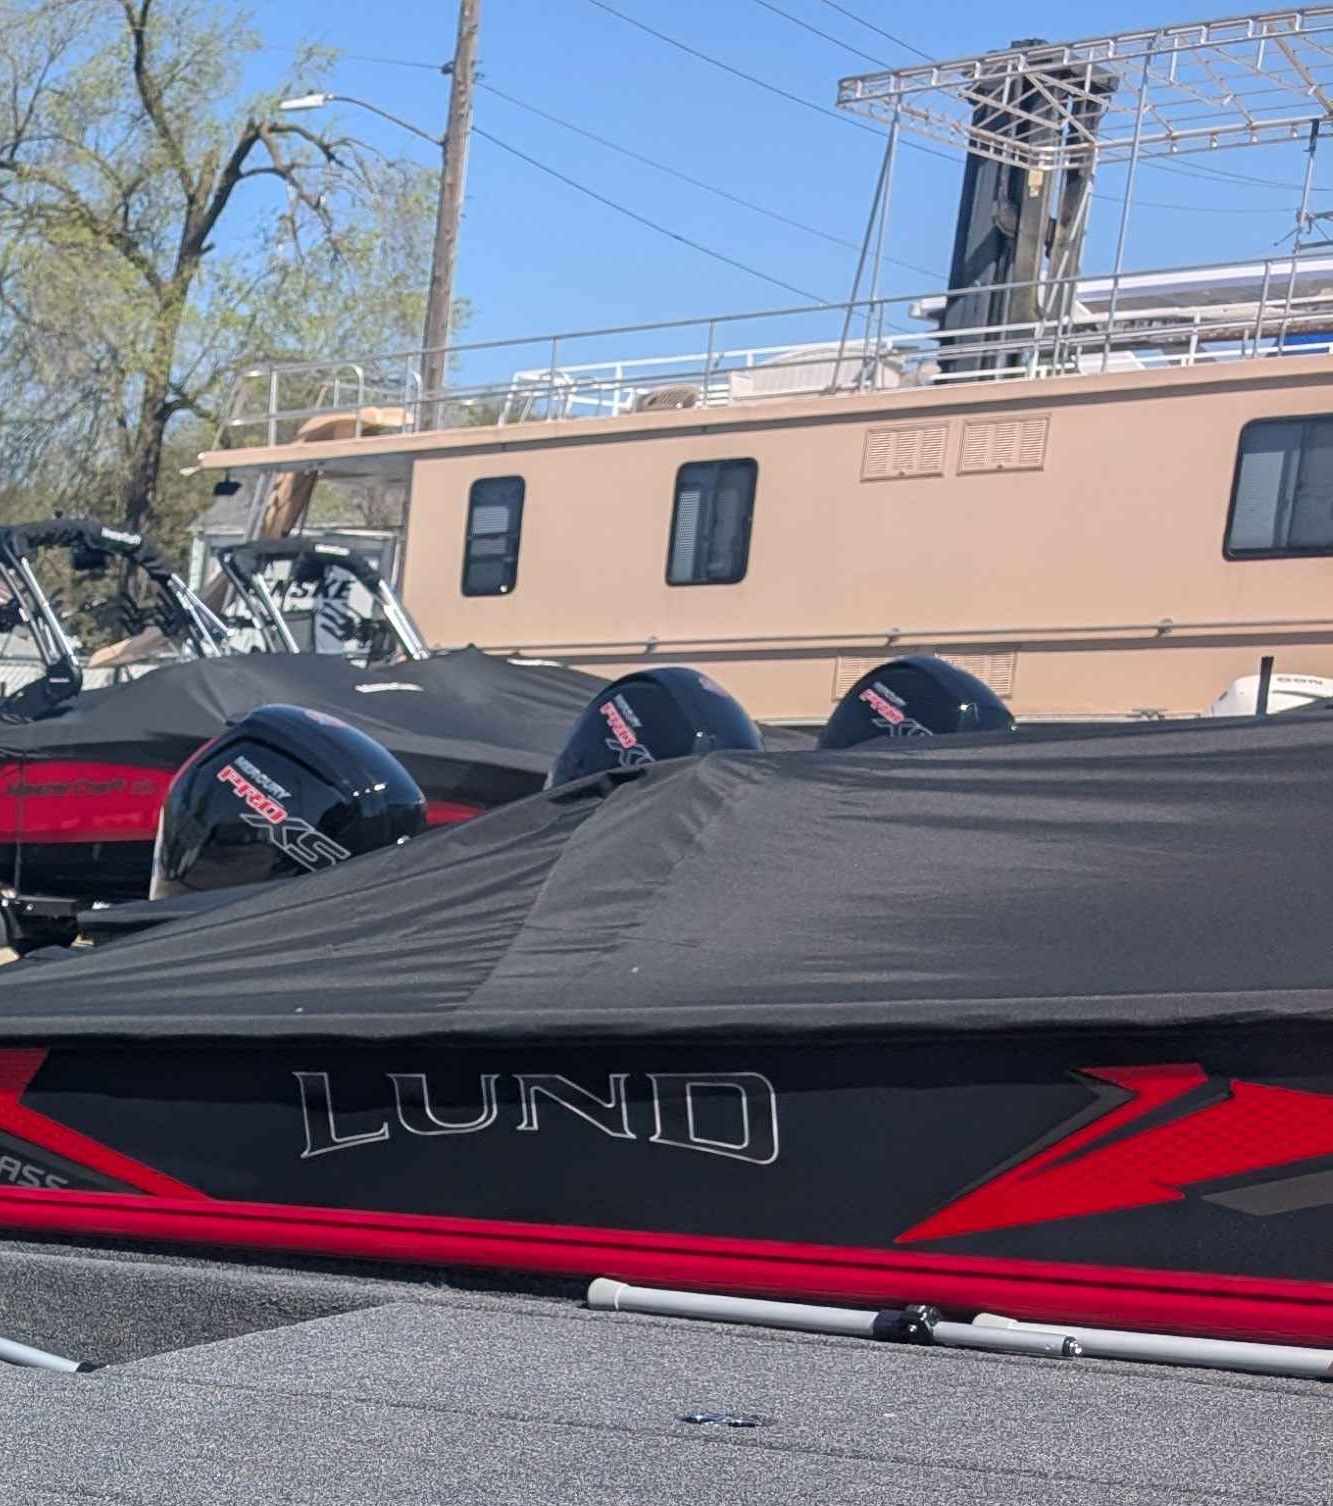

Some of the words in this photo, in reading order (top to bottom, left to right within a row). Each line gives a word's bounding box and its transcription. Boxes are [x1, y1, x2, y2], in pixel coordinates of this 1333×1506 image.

[234, 755, 292, 799] MERCURY
[605, 738, 655, 767] X
[216, 764, 288, 824] PRO
[292, 1071, 780, 1164] LUND
